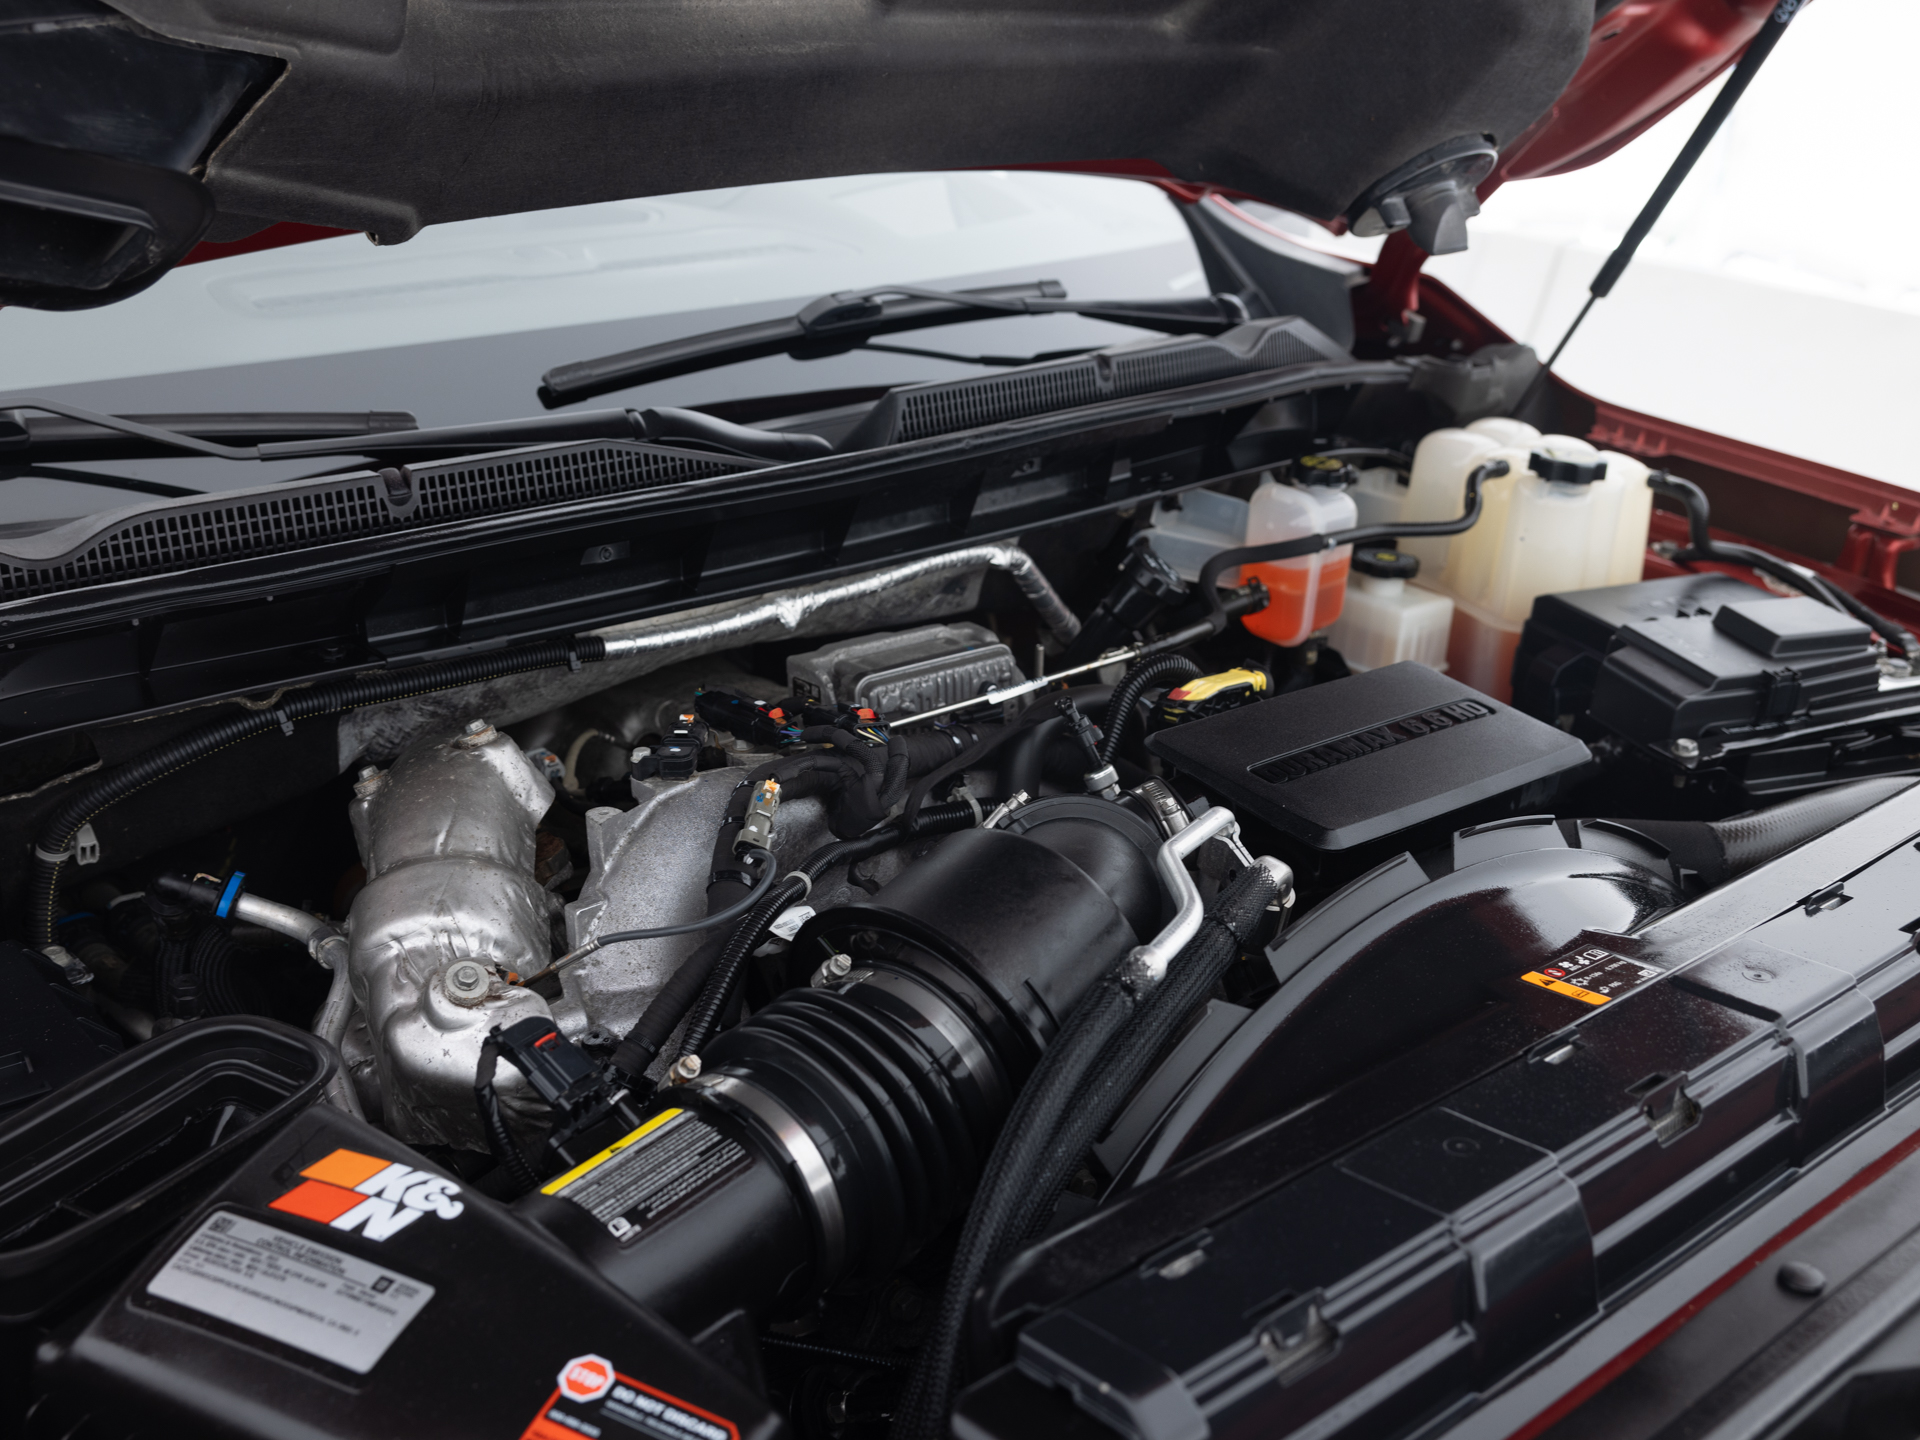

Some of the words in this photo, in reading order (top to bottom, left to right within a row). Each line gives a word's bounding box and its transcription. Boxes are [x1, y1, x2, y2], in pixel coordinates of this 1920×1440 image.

[1256, 726, 1405, 784] DURAMAX
[1401, 713, 1452, 736] 6.6
[1448, 700, 1489, 723] HD
[567, 1365, 606, 1390] STOP
[611, 1385, 636, 1404] DO
[634, 1394, 666, 1416] NOT
[661, 1406, 728, 1440] DISCARD
